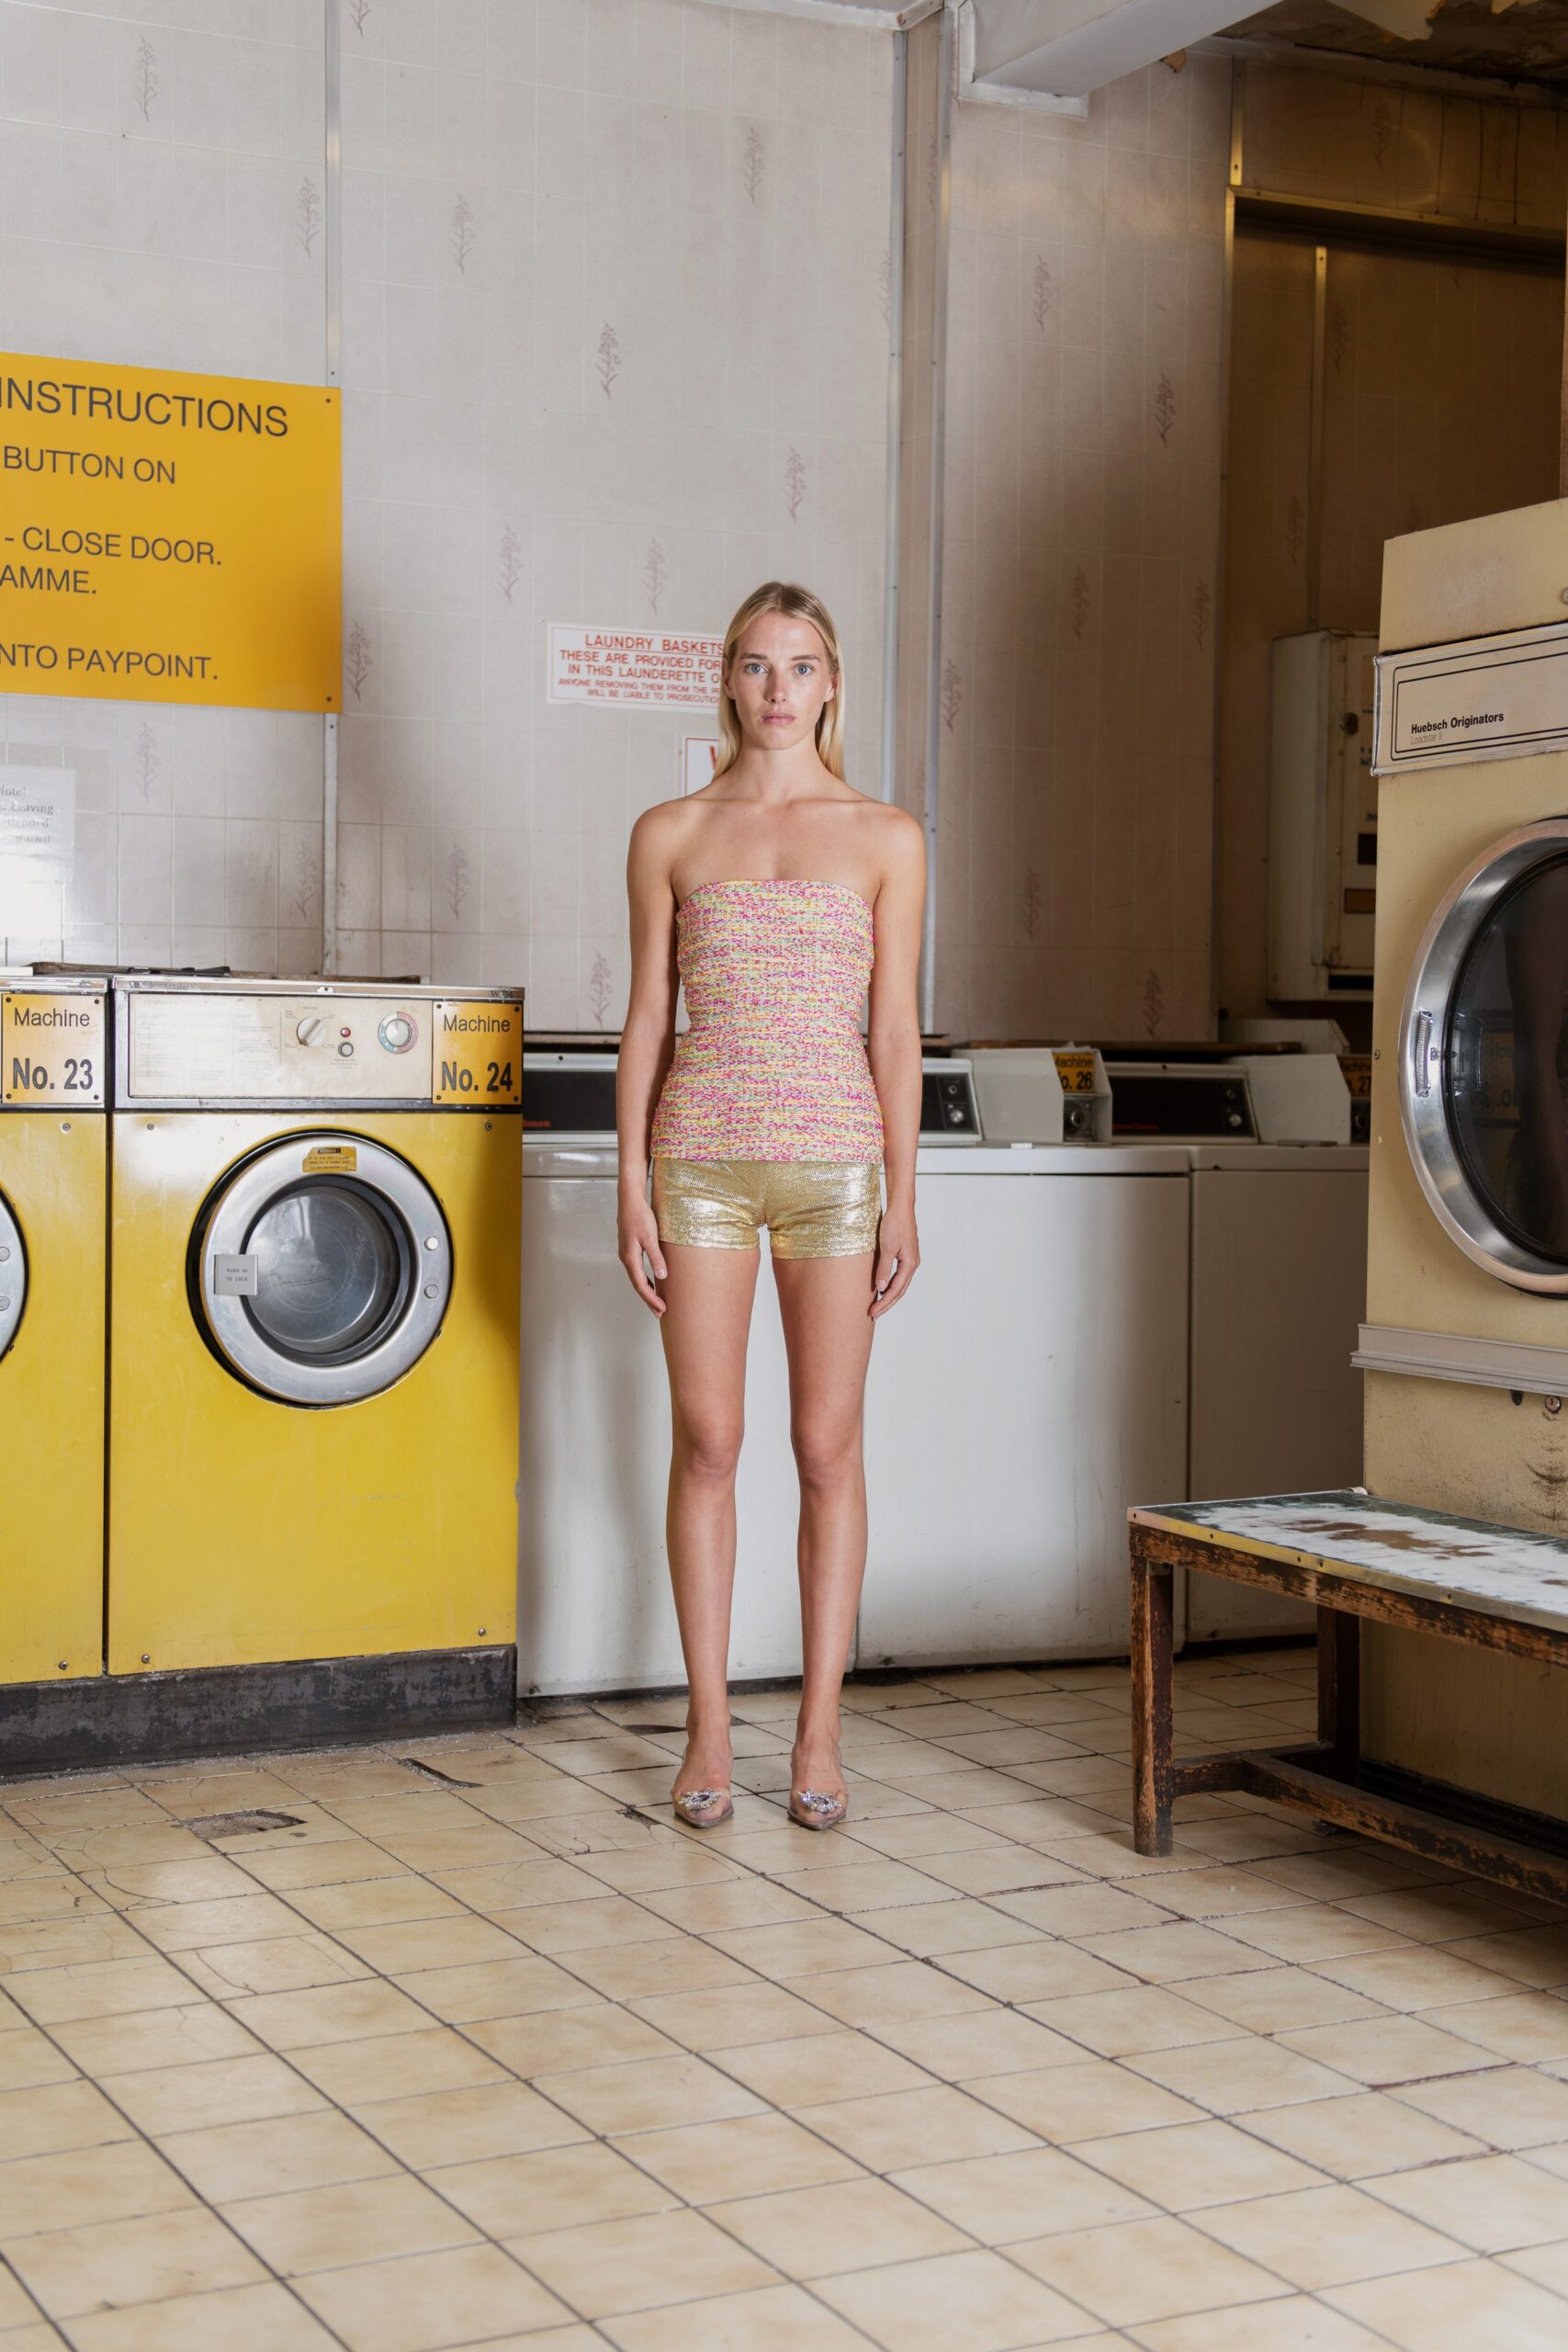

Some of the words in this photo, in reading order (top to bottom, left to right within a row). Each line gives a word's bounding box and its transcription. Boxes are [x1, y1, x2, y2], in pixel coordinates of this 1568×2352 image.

[0, 377, 288, 437] INSTRUCTIONS
[4, 446, 124, 480] BUTTON
[133, 458, 176, 485] ON
[23, 526, 122, 558] CLOSE
[130, 536, 222, 566] DOOR.
[585, 634, 654, 650] LAUNDRY
[661, 639, 724, 656] BASKETS
[67, 647, 219, 681] PAYPOINT.
[559, 650, 600, 662] THESE
[605, 652, 629, 664] ARE
[635, 654, 694, 669] PROVIDED
[698, 659, 721, 671] FOR
[568, 663, 581, 674] IN
[586, 664, 613, 677] THIS
[619, 666, 705, 684] LAUNDERETTE
[558, 677, 591, 687] ANYONE
[595, 679, 638, 690] REMOVING
[641, 682, 663, 691] THEM
[667, 684, 689, 693] FROM
[693, 685, 707, 695] THE
[587, 688, 605, 696] WILL
[608, 689, 619, 698] BE
[623, 690, 650, 700] LIABLE
[1410, 719, 1448, 735] Huebsch
[1450, 713, 1505, 729] Originators
[1410, 732, 1438, 745] Loadstar
[14, 1007, 90, 1027] Machine
[443, 1013, 511, 1033] Machine
[13, 1057, 55, 1091] No.
[63, 1058, 94, 1091] 23
[442, 1061, 479, 1091] No.
[486, 1062, 513, 1091] 24
[1076, 1071, 1093, 1091] 26
